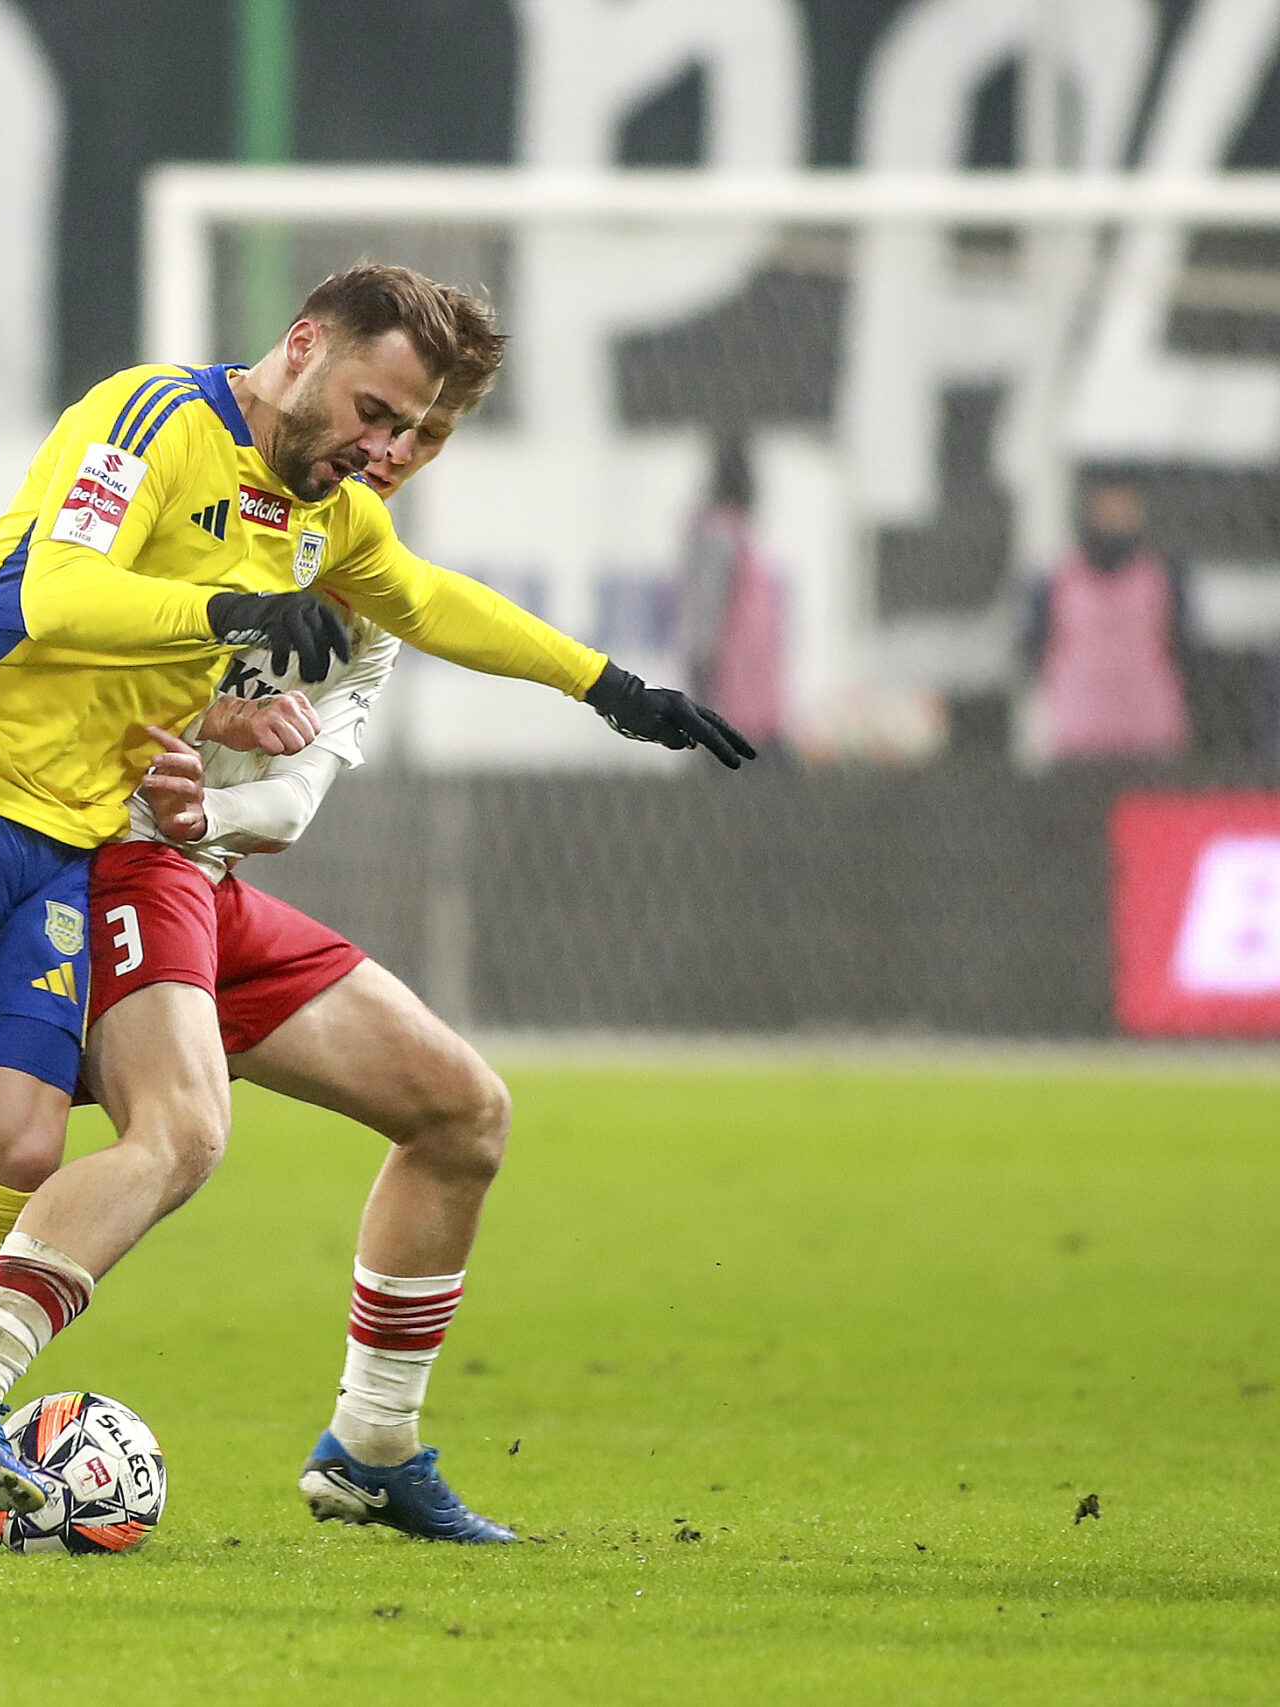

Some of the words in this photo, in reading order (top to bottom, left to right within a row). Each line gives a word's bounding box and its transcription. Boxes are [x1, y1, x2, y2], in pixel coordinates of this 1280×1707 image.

[84, 466, 127, 493] SUZUKI
[69, 487, 122, 516] Betclic
[239, 491, 286, 524] Betclic
[105, 904, 144, 977] 3
[96, 1413, 153, 1500] SELECT
